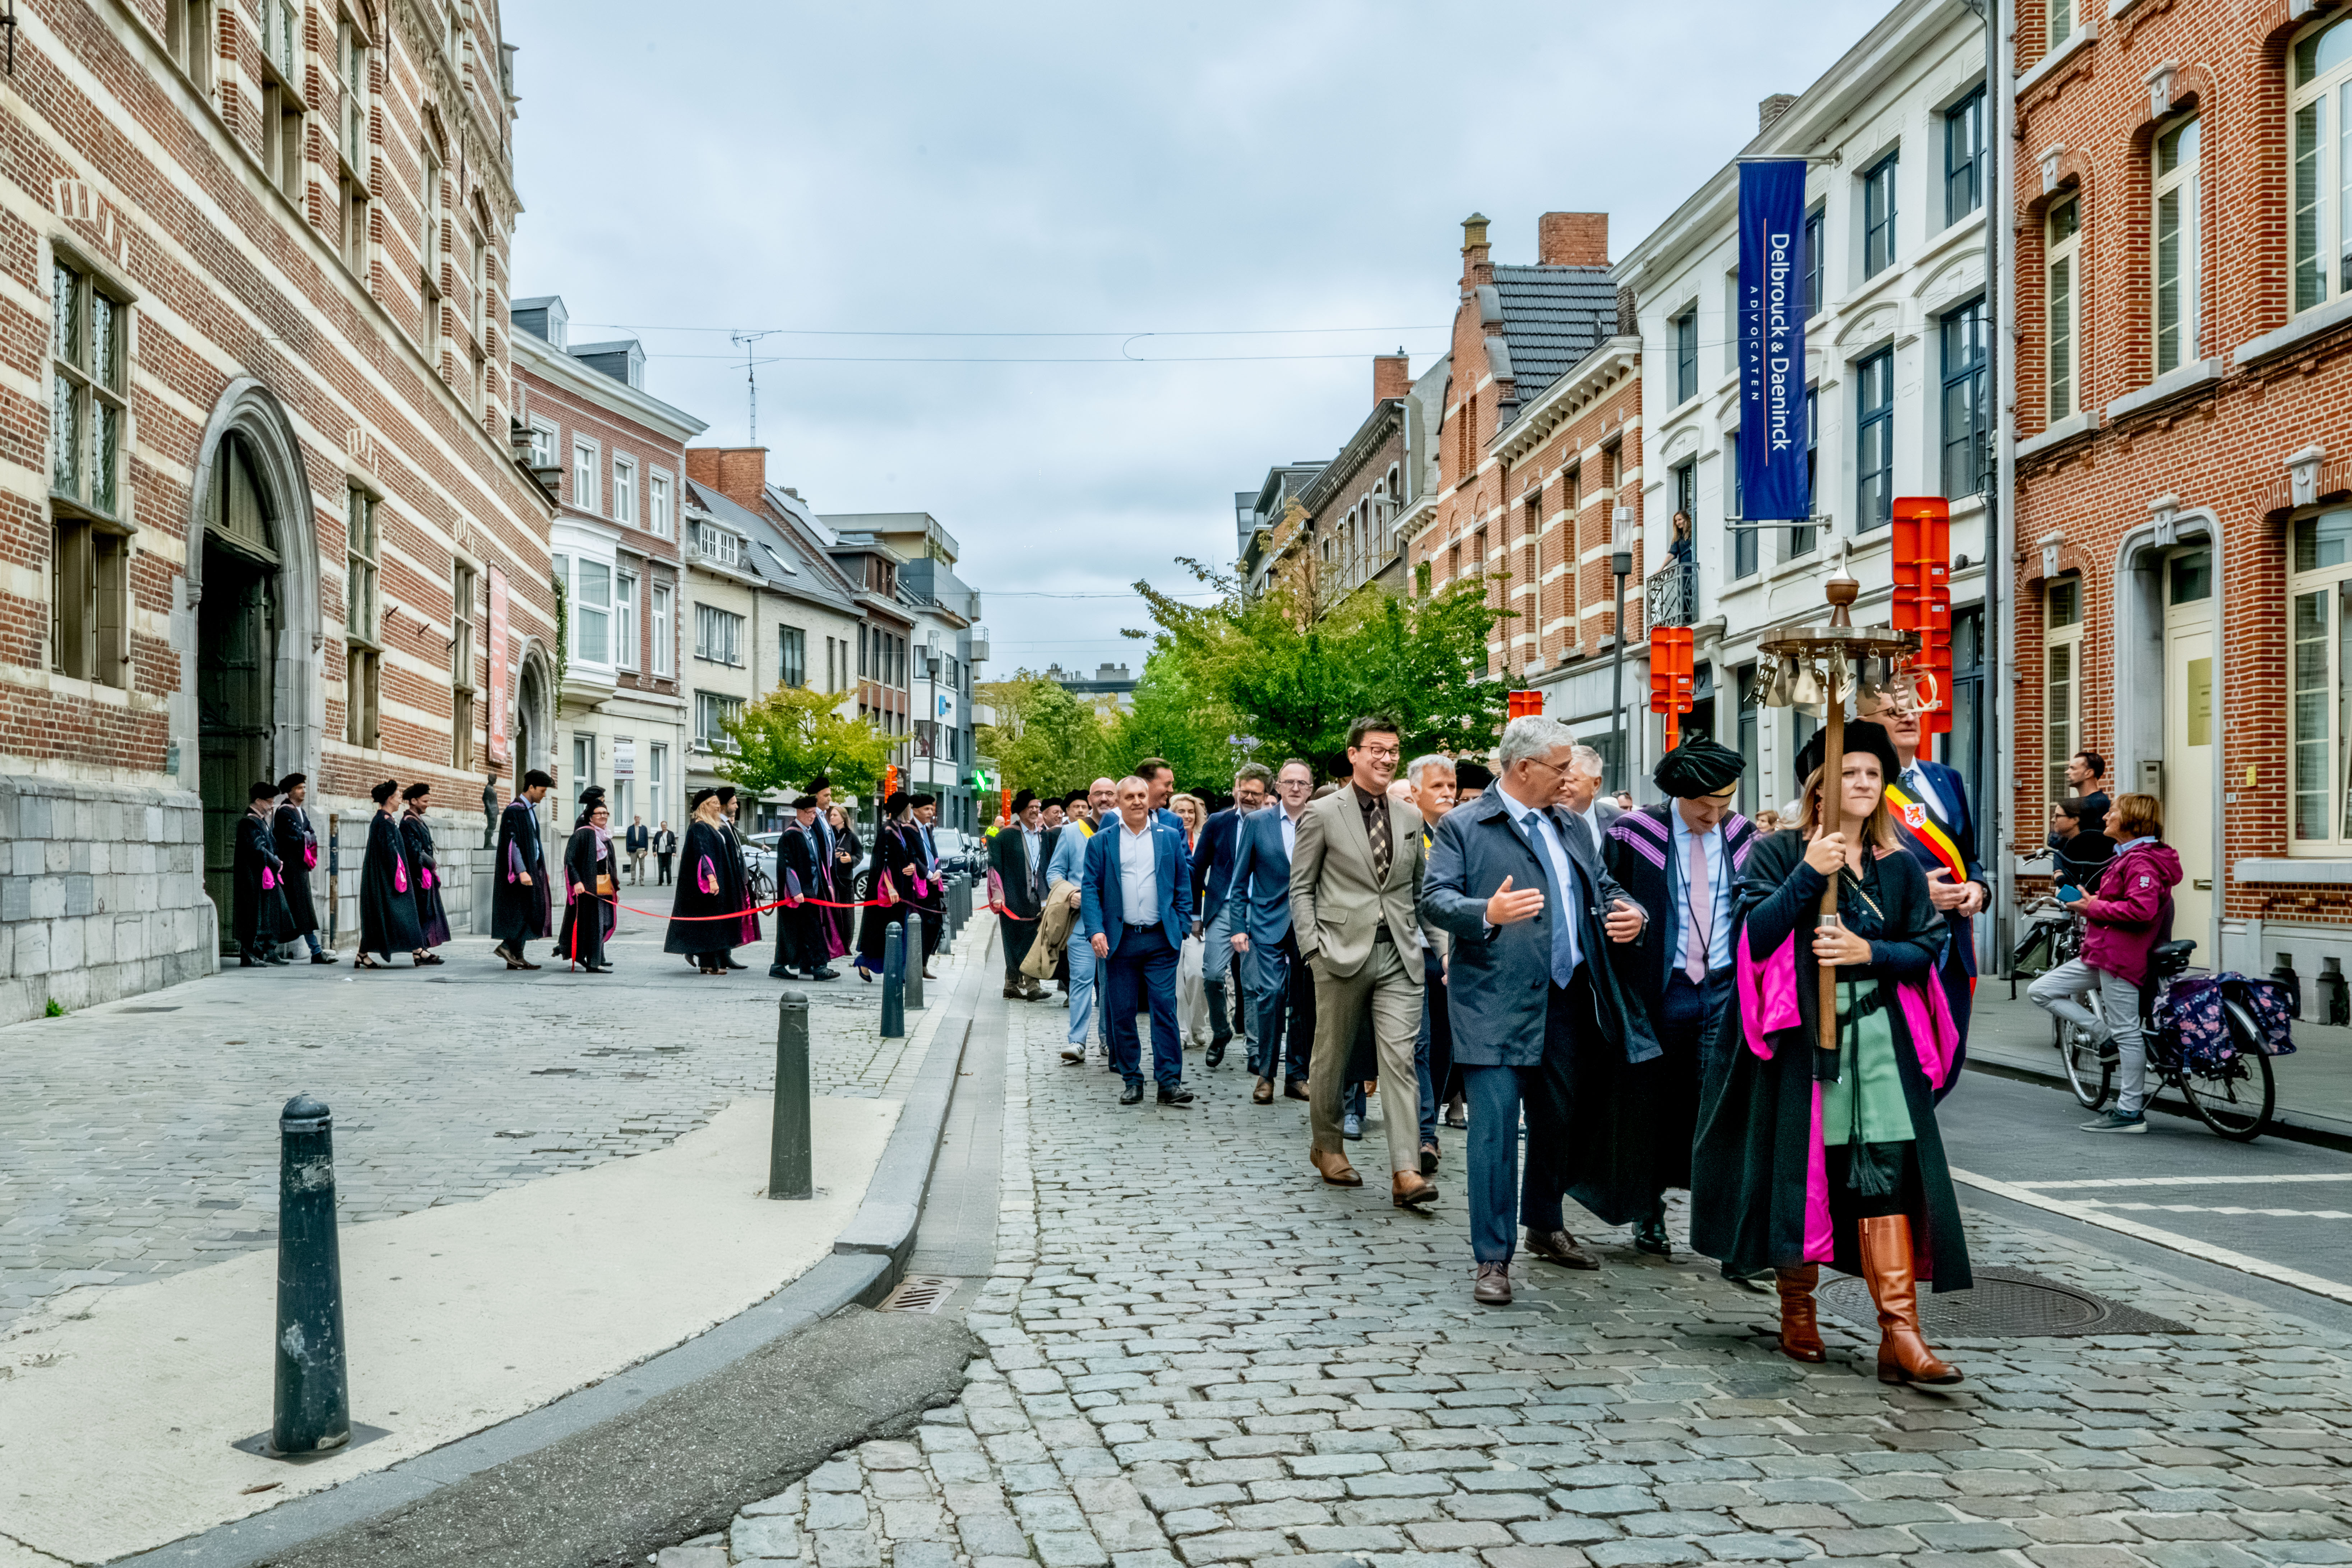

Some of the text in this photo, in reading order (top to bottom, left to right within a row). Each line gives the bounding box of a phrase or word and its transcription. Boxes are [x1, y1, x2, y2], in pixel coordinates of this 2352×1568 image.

[1750, 286, 1759, 400] ADVOCATEN
[1771, 234, 1791, 450] Delbrouck & Daeninck
